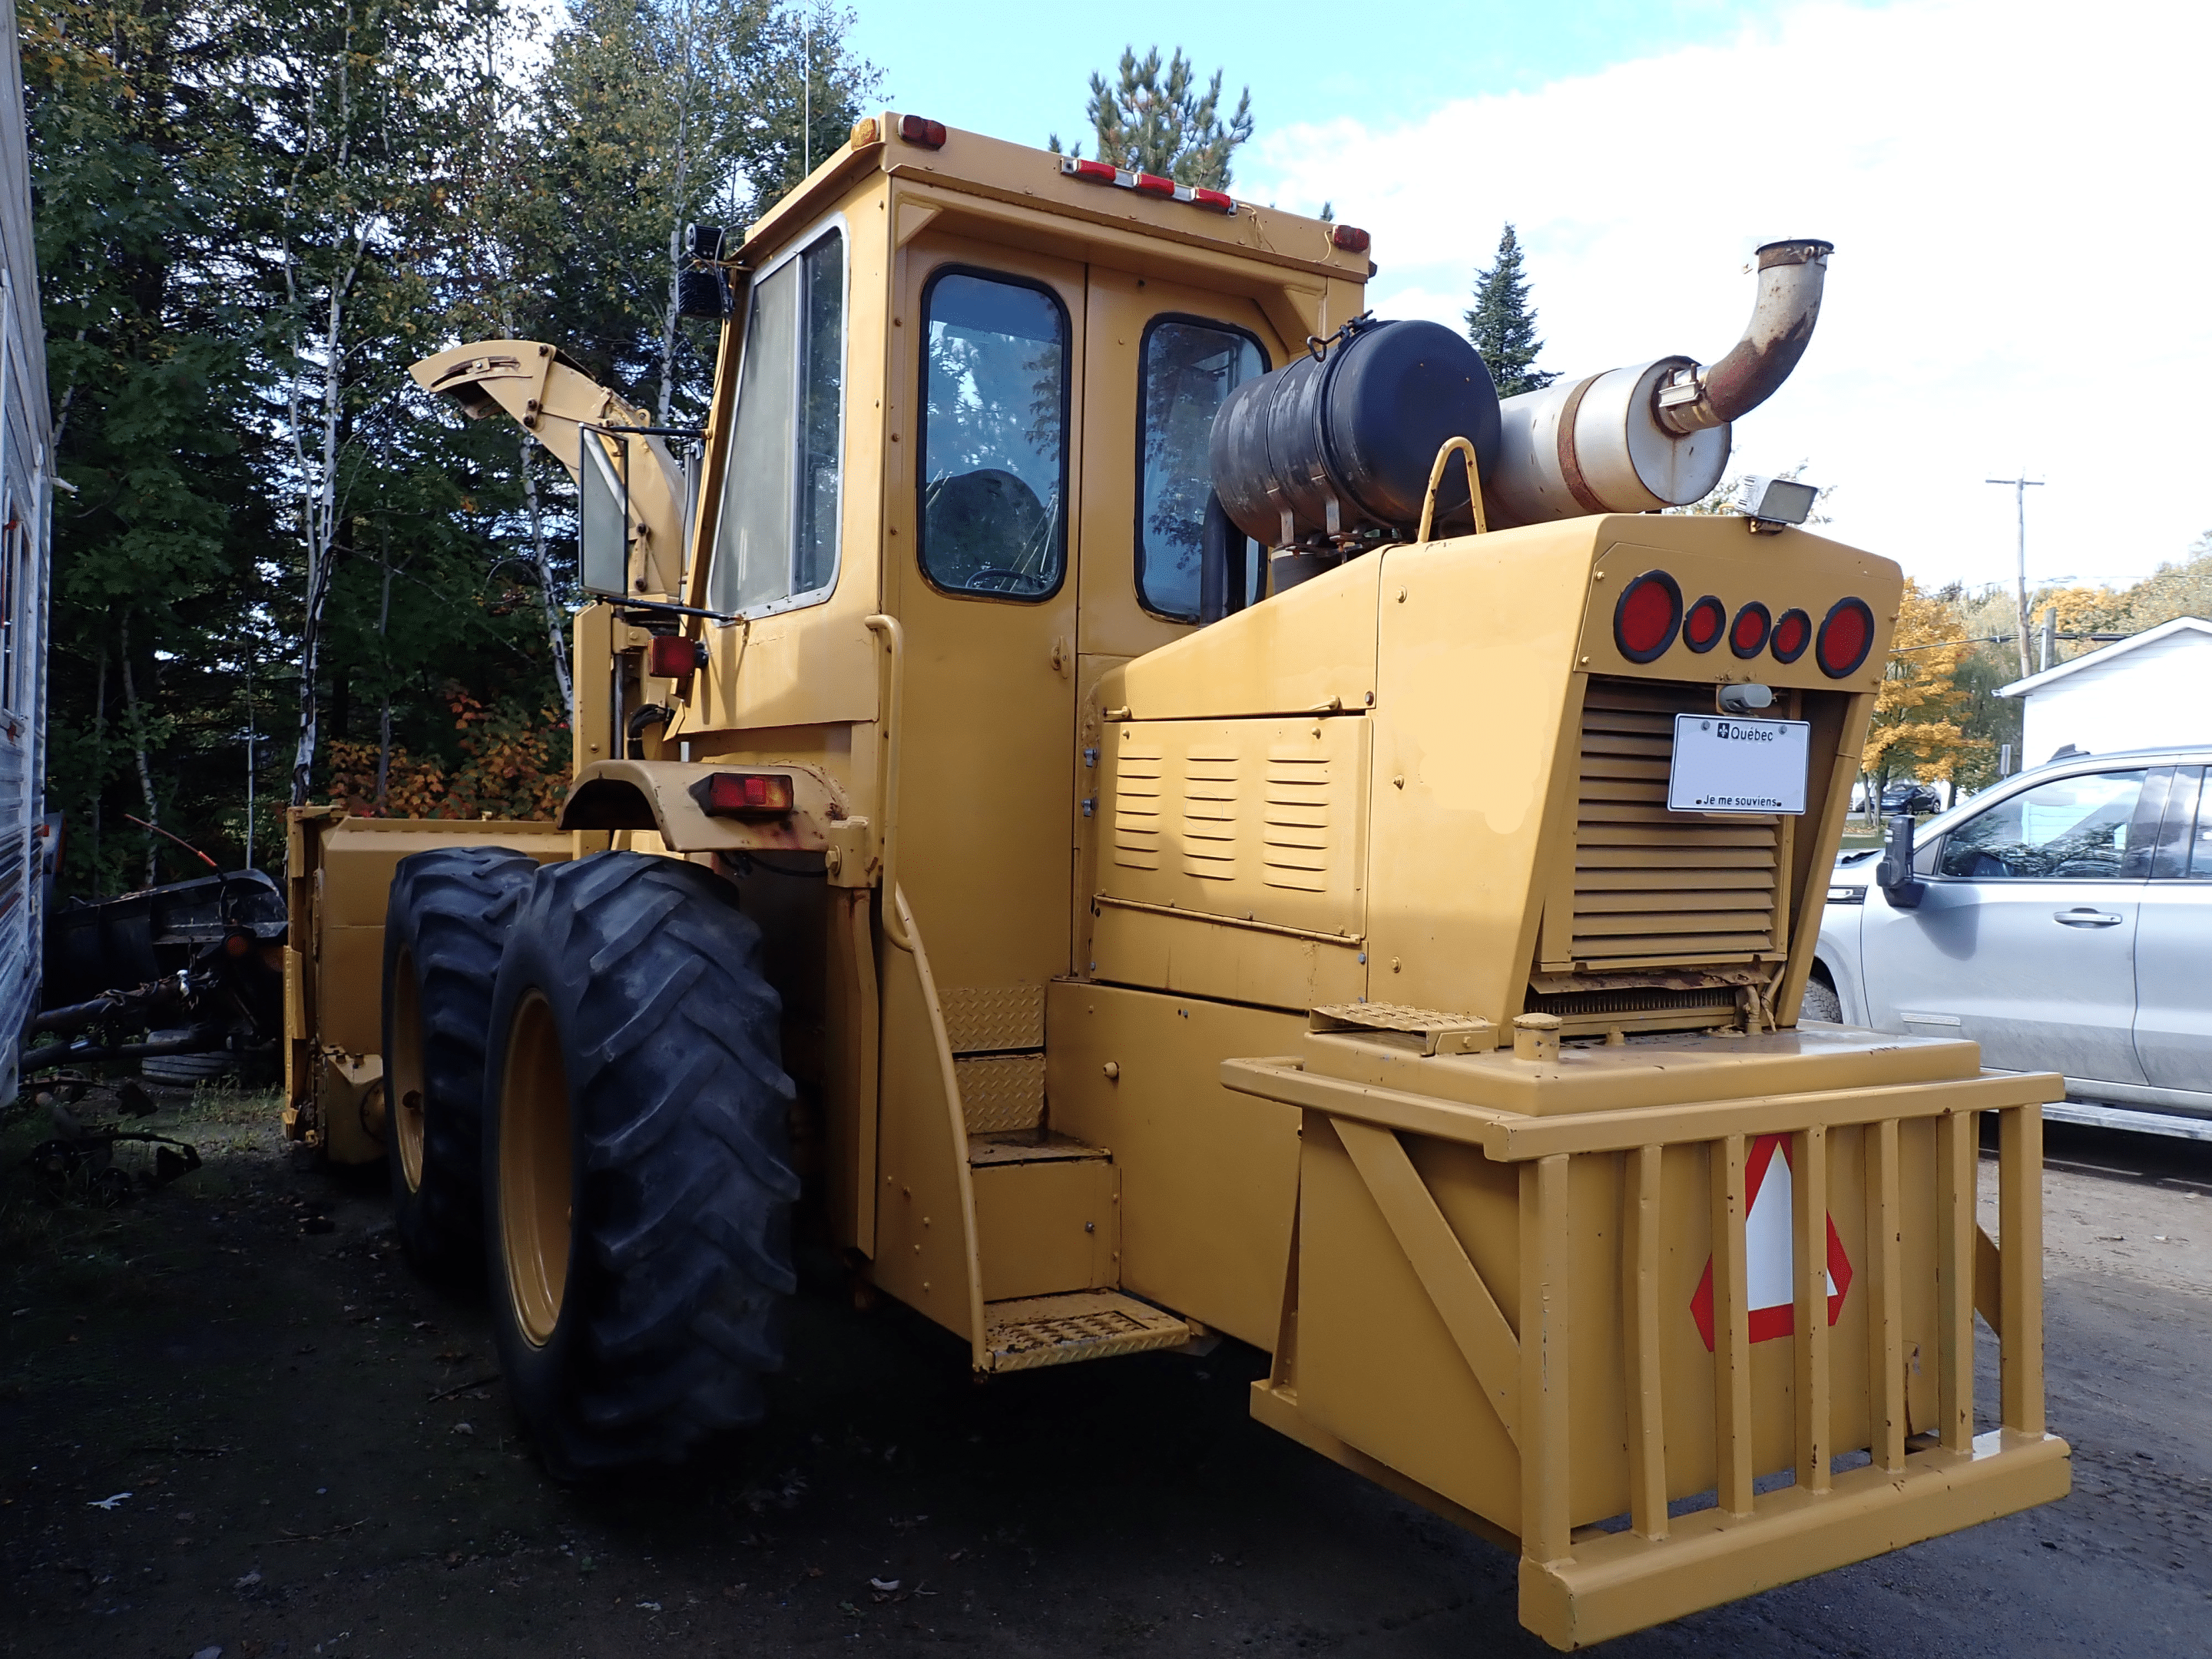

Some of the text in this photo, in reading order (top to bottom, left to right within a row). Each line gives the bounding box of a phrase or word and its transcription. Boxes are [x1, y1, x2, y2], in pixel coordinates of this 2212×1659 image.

[1730, 726, 1773, 741] Québec
[1704, 794, 1777, 806] Je me souviens
